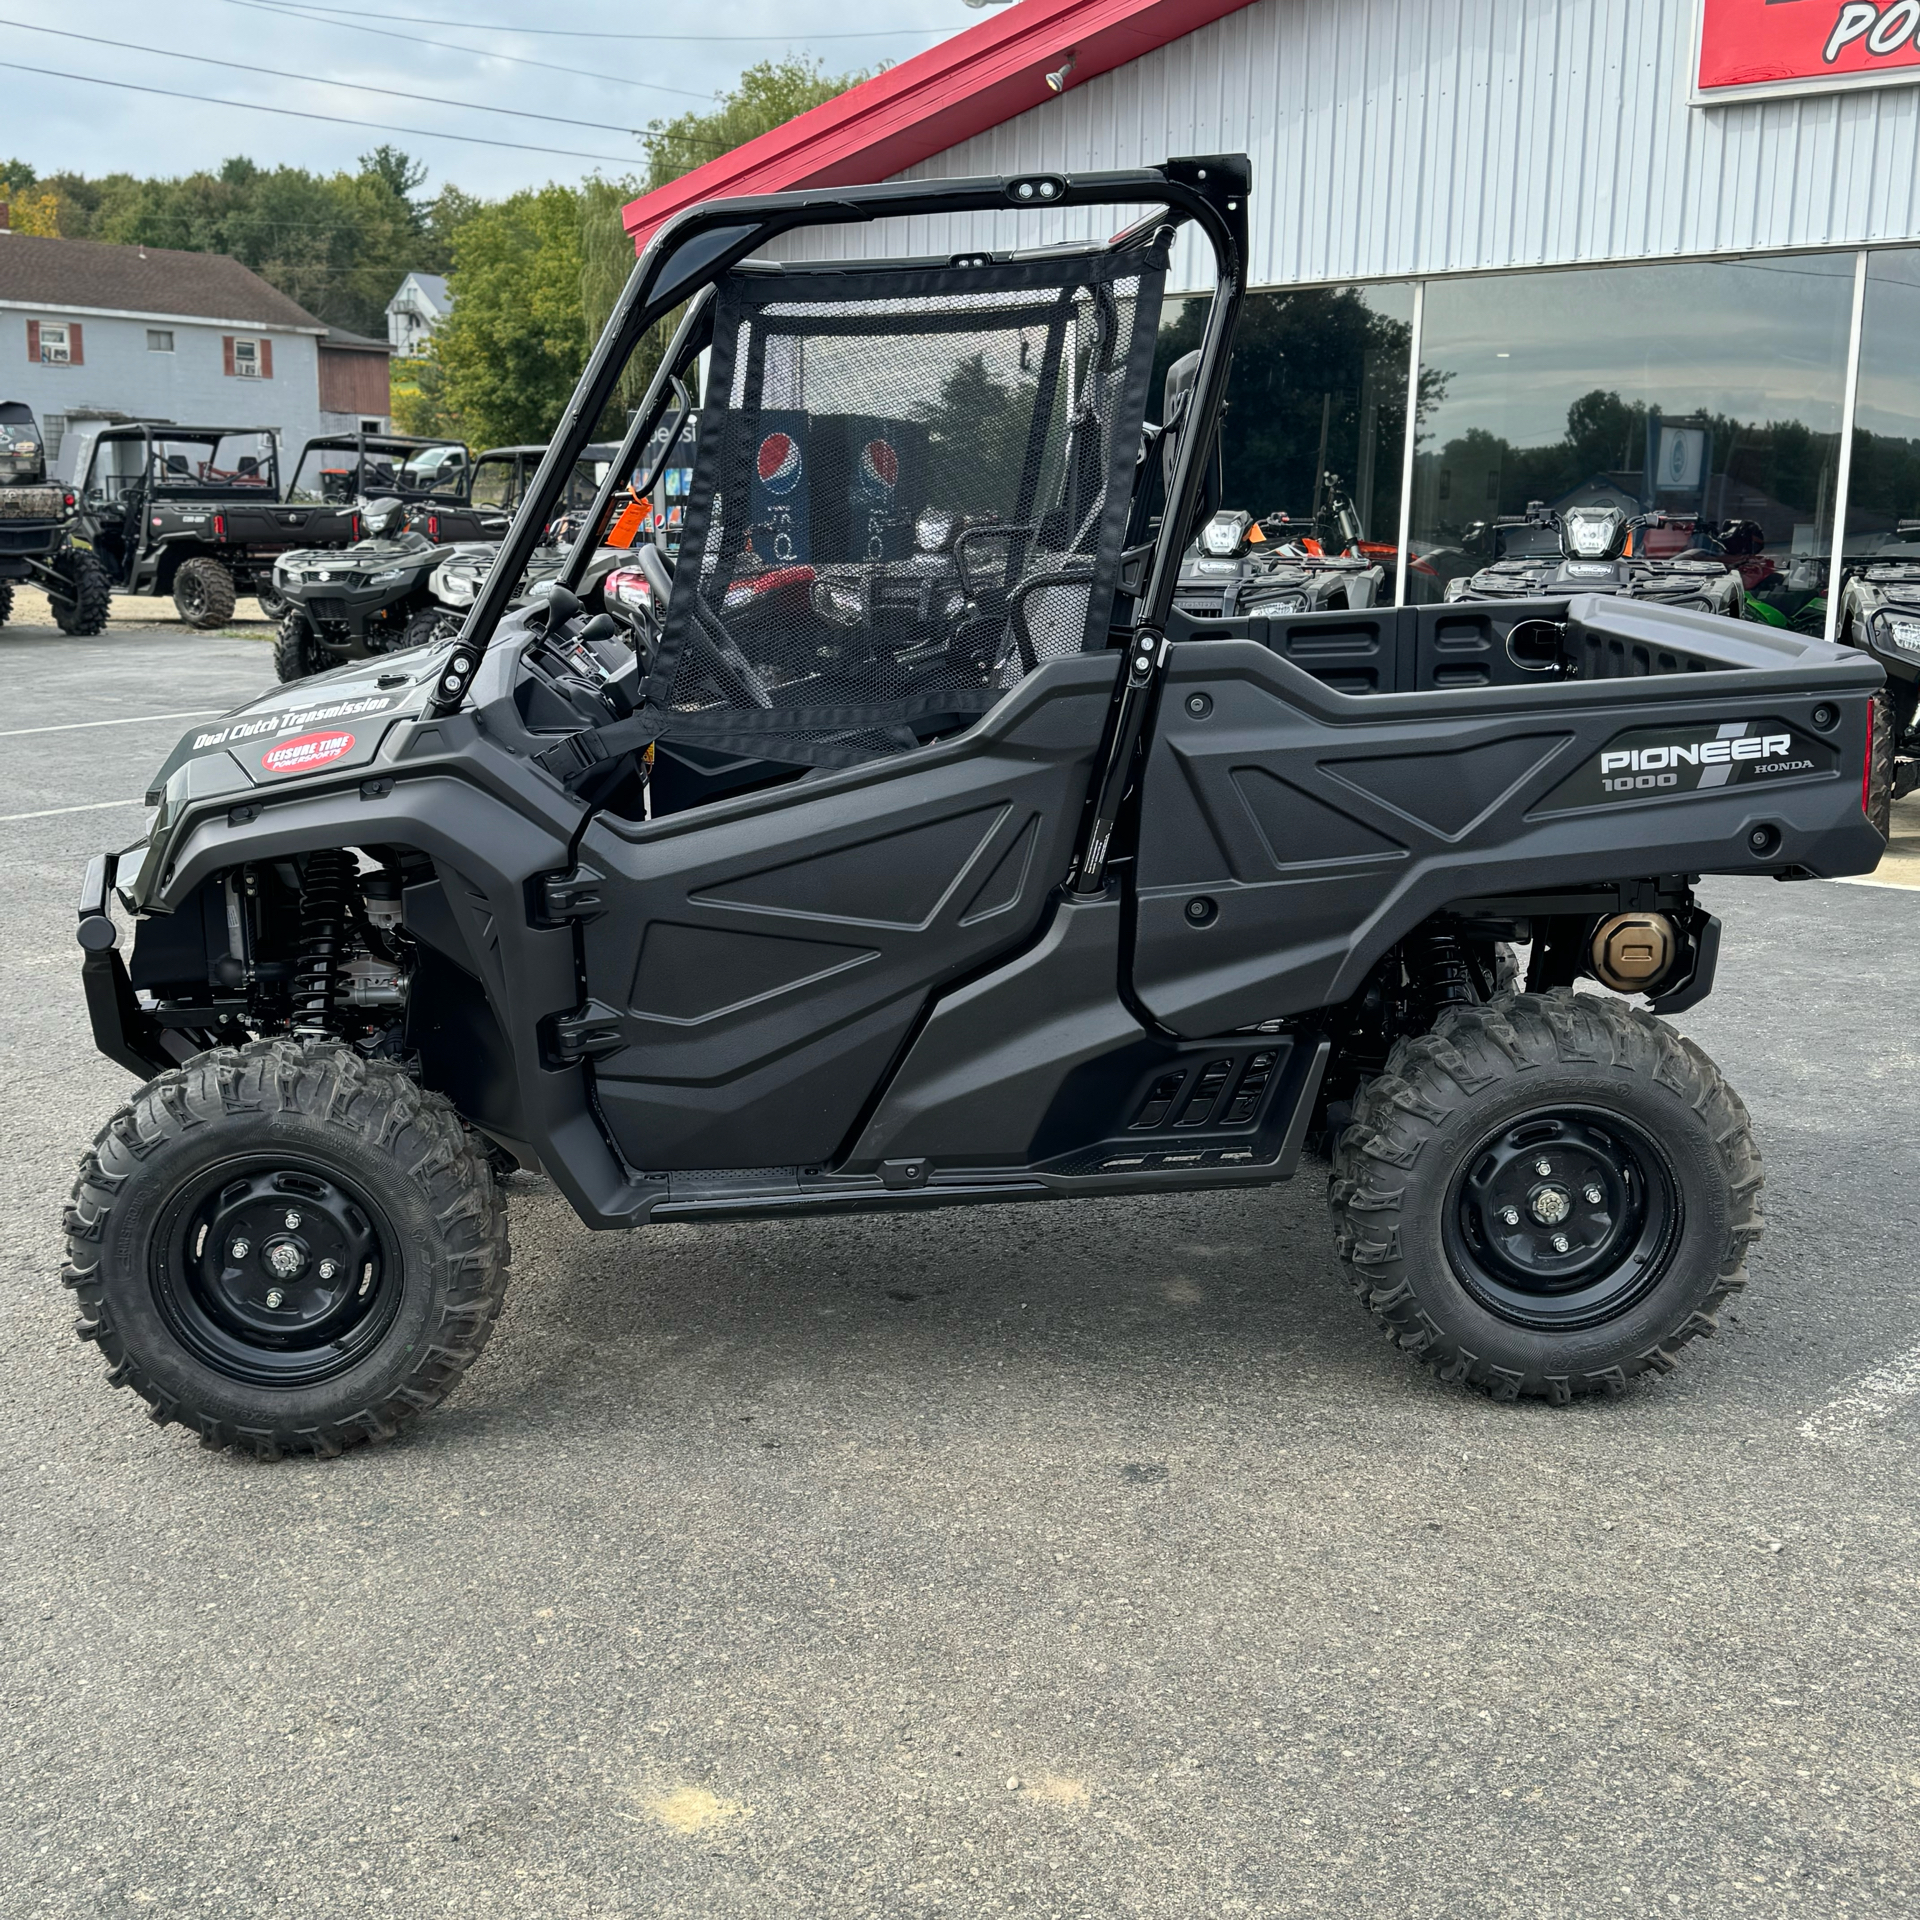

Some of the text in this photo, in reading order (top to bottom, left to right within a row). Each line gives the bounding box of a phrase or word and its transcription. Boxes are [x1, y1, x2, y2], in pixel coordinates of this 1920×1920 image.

[1822, 0, 1920, 64] PO
[649, 414, 697, 446] esi
[193, 697, 391, 750] Dual Clutch Transmission
[266, 735, 349, 763] LEISURE TIME
[272, 748, 342, 769] POWERSPORTS
[1601, 734, 1791, 774] PIONEER
[1754, 759, 1815, 774] HONDA
[1602, 773, 1677, 792] 1000
